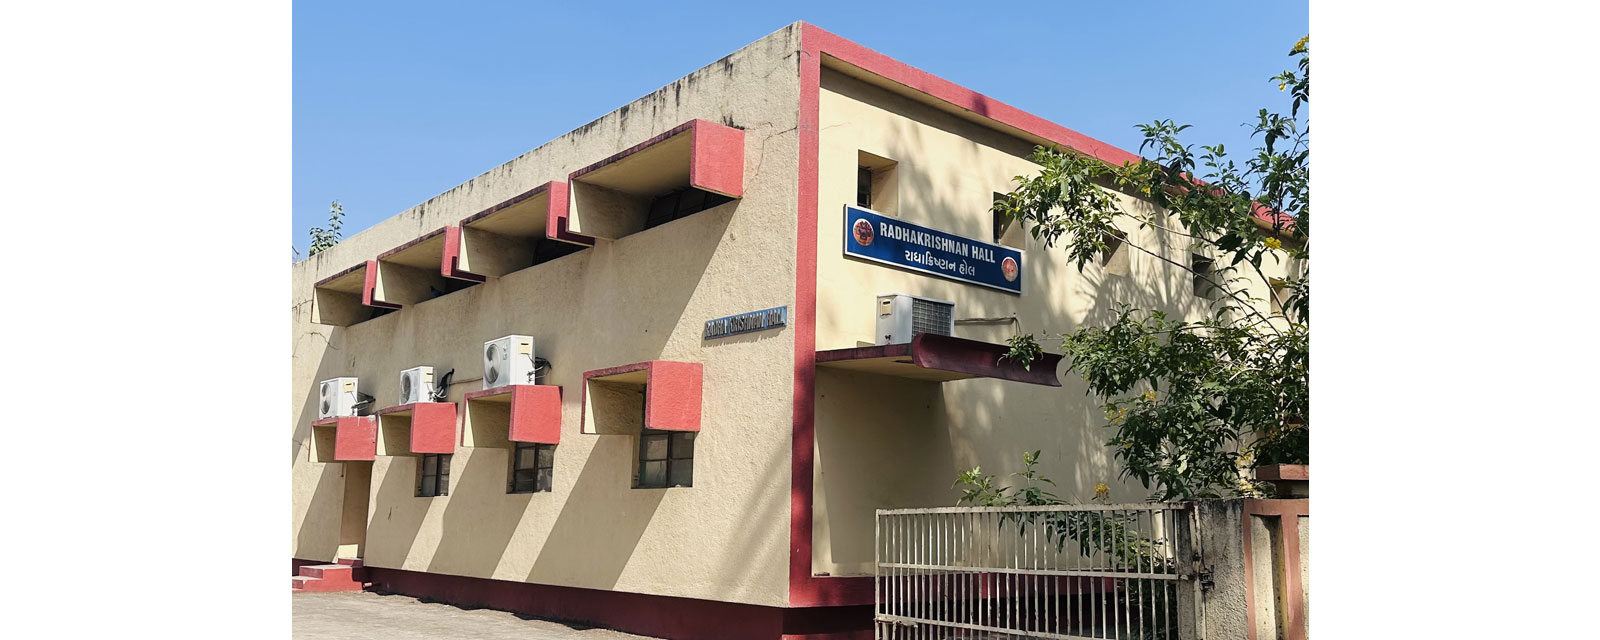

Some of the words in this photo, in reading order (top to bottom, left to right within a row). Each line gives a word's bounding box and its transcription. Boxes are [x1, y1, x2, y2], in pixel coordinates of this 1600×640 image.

[880, 222, 968, 257] RADHAKRISHNAN
[972, 246, 995, 263] HALL
[959, 259, 975, 276] હોલ
